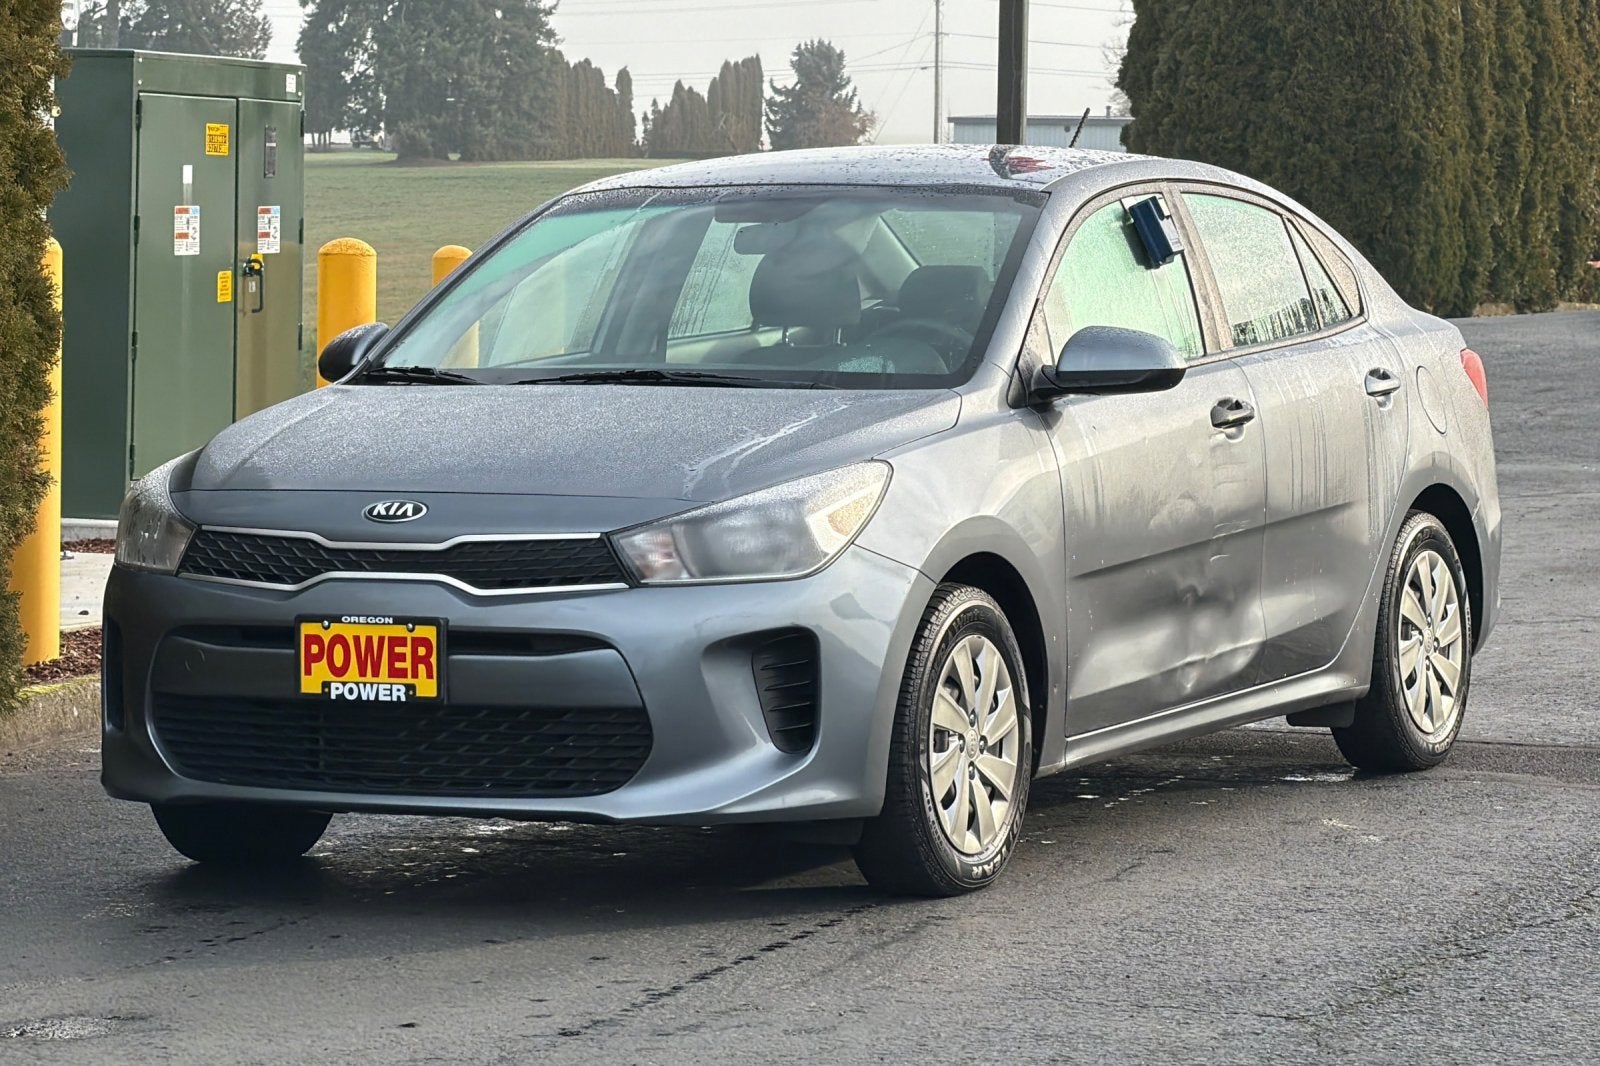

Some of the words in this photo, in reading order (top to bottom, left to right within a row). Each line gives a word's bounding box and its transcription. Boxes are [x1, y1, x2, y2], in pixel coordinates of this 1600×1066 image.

[372, 502, 414, 517] KIA
[341, 615, 393, 624] OREGON
[304, 633, 434, 679] POWER
[330, 682, 406, 701] POWER
